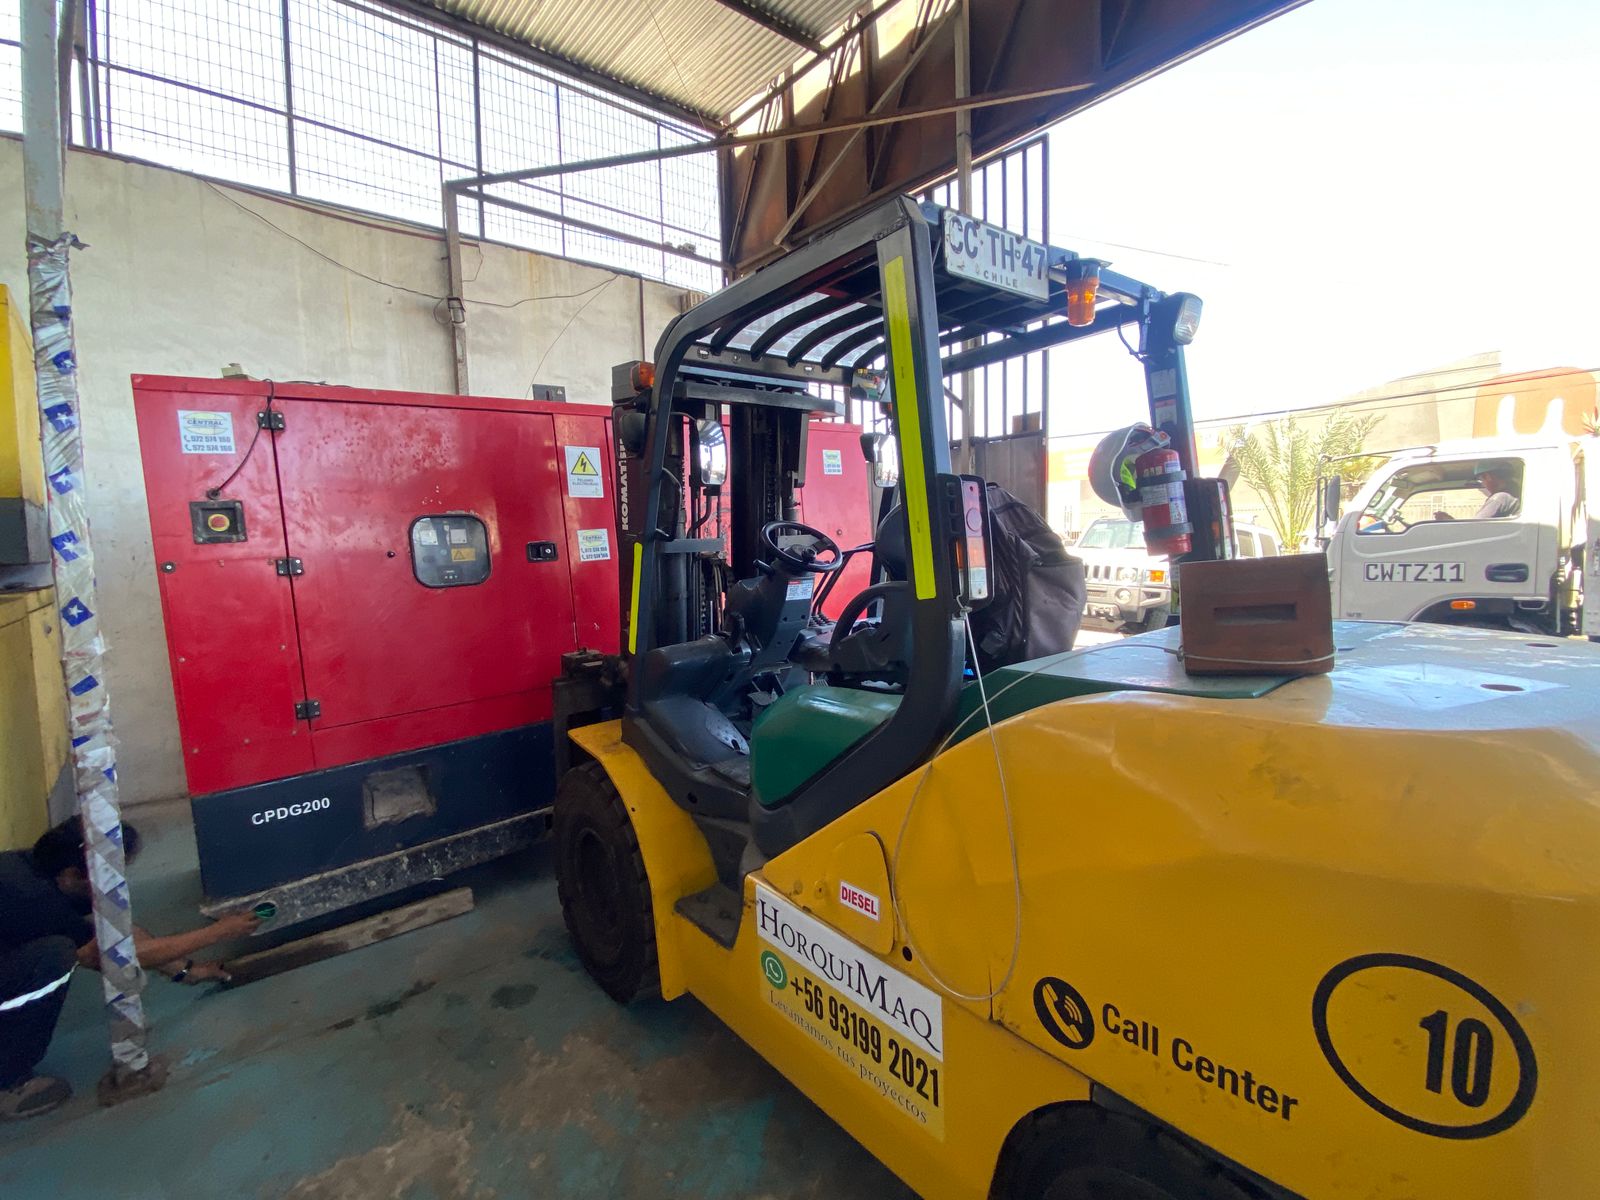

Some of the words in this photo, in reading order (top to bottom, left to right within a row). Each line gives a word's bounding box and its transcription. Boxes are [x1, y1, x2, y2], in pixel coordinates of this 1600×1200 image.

[983, 270, 1018, 289] CHILE
[251, 797, 330, 825] CPDG200
[841, 885, 877, 916] DIESEL
[769, 990, 834, 1050] Levantamos
[837, 1046, 855, 1068] tus
[860, 1063, 927, 1124] proyectos
[790, 976, 824, 1020] +56
[829, 995, 882, 1064] 93199
[888, 1038, 939, 1108] 2021
[1102, 1003, 1159, 1056] Call
[1171, 1037, 1299, 1121] Center
[1418, 1009, 1494, 1108] 10
